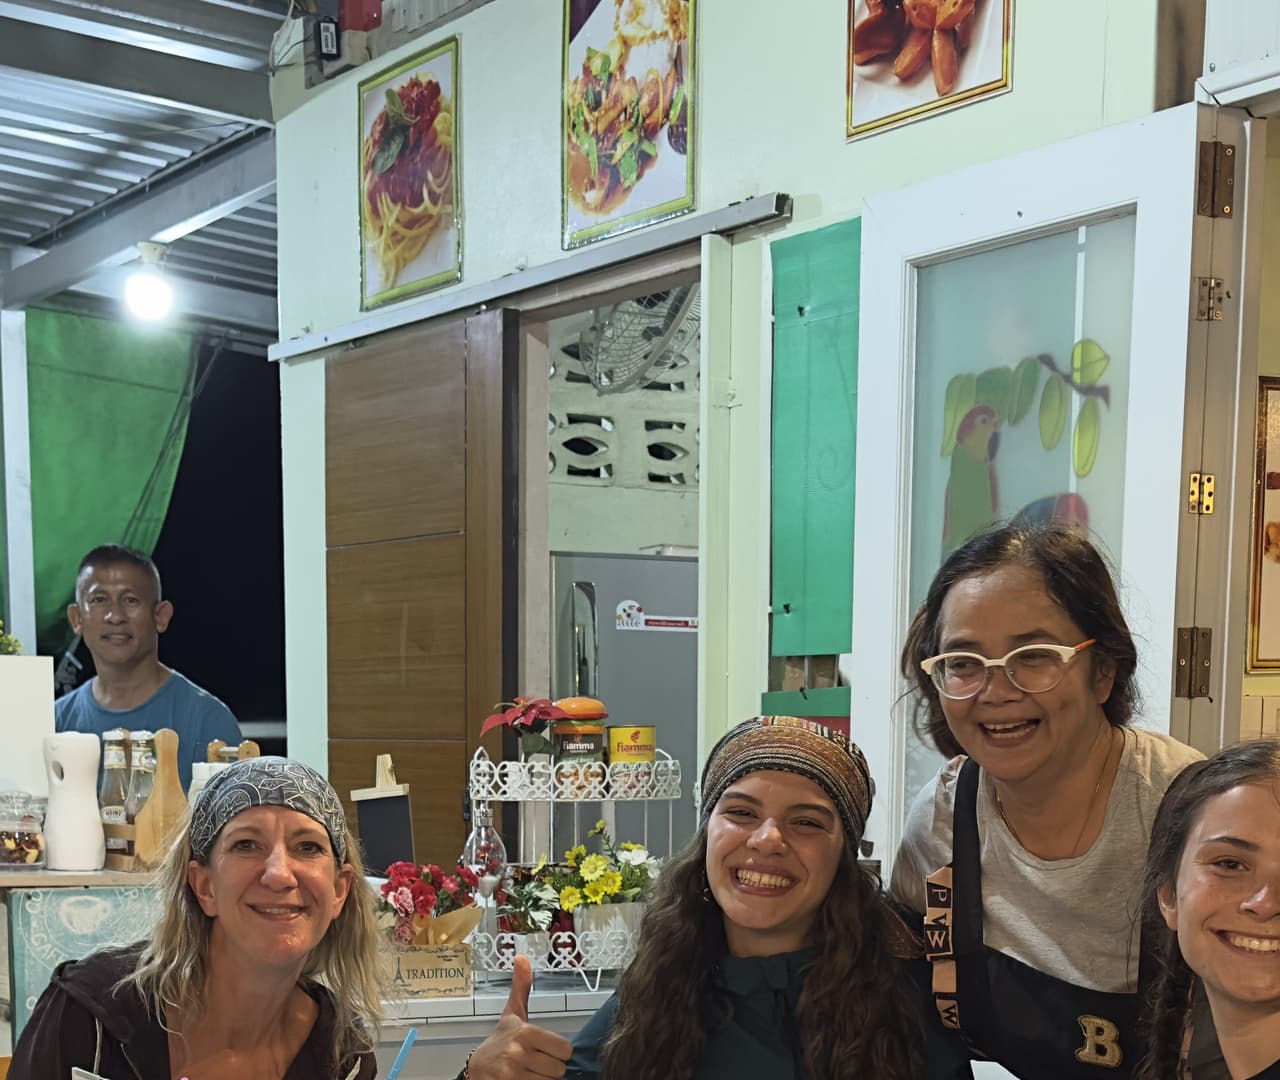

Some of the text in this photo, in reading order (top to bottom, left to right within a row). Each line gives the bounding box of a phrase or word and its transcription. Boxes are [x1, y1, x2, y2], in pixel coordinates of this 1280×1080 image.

[562, 741, 594, 750] fiamma
[616, 742, 656, 753] fiamma
[406, 967, 464, 980] TRADITION
[1074, 1014, 1123, 1068] B
